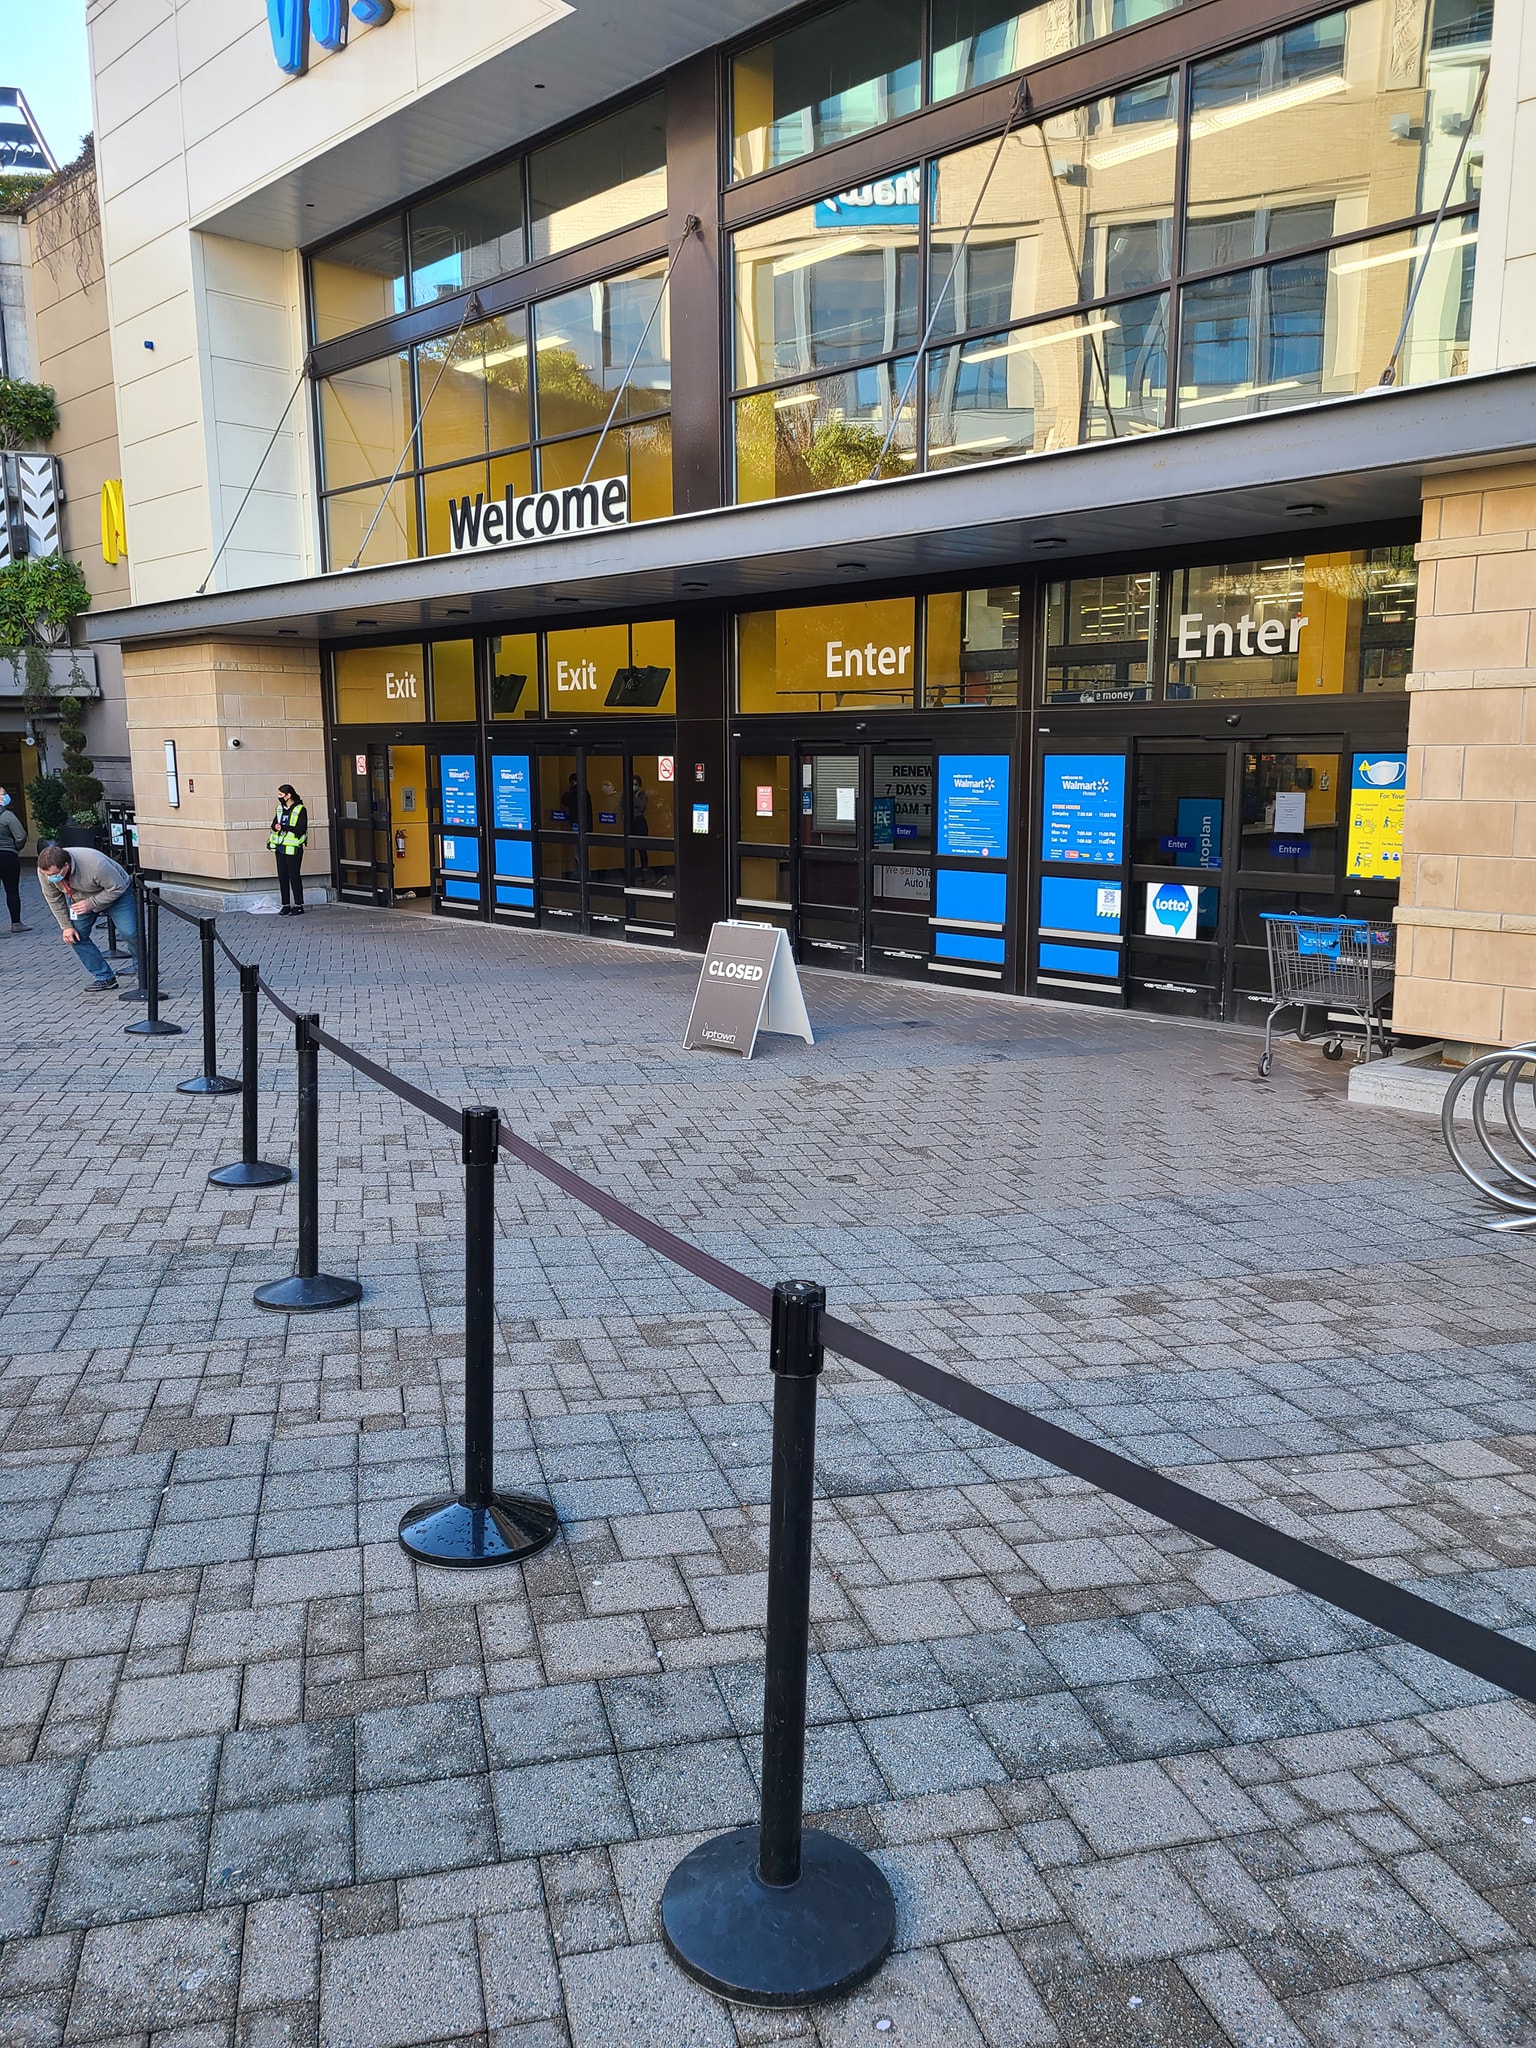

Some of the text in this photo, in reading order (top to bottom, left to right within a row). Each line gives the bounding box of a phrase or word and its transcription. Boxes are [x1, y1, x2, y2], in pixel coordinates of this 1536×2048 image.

[448, 478, 627, 549] Welcome
[1178, 613, 1309, 659] Enter
[826, 641, 911, 678] Enter
[557, 658, 597, 691] Exit
[385, 671, 417, 699] Exit
[1102, 691, 1134, 702] money
[885, 784, 927, 796] 7 DAYS
[954, 779, 984, 788] Walmart
[1062, 780, 1096, 790] Walmart
[1167, 840, 1188, 849] Enter
[1279, 845, 1301, 854] Enter
[904, 878, 923, 888] Auto
[1155, 898, 1190, 912] lotto!
[709, 960, 763, 981] CLOSED
